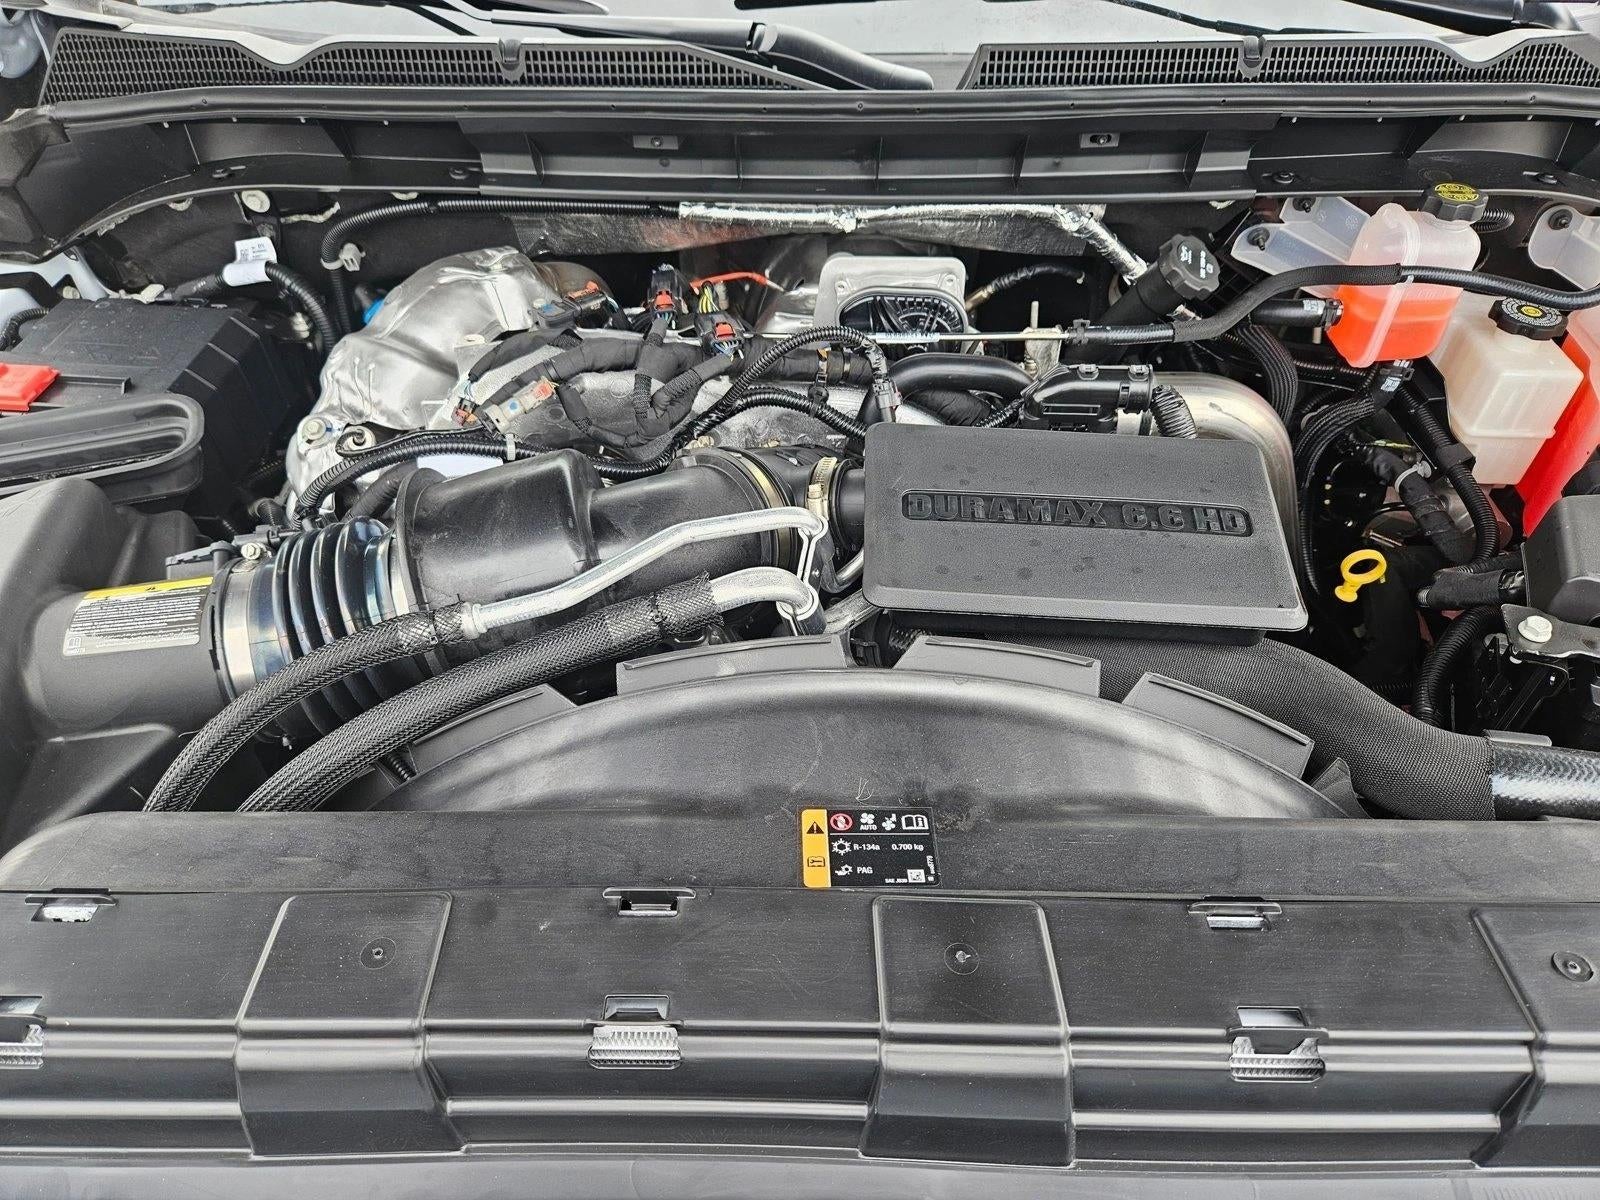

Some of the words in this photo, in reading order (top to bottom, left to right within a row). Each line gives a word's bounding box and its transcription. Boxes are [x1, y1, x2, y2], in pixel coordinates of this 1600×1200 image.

[906, 492, 1107, 526] DURAMAX
[1121, 502, 1186, 531] 6.6
[1194, 506, 1248, 534] HD
[853, 843, 881, 851] R-134a
[891, 843, 913, 851] 0.700
[913, 843, 924, 852] kg
[856, 866, 874, 874] PAG
